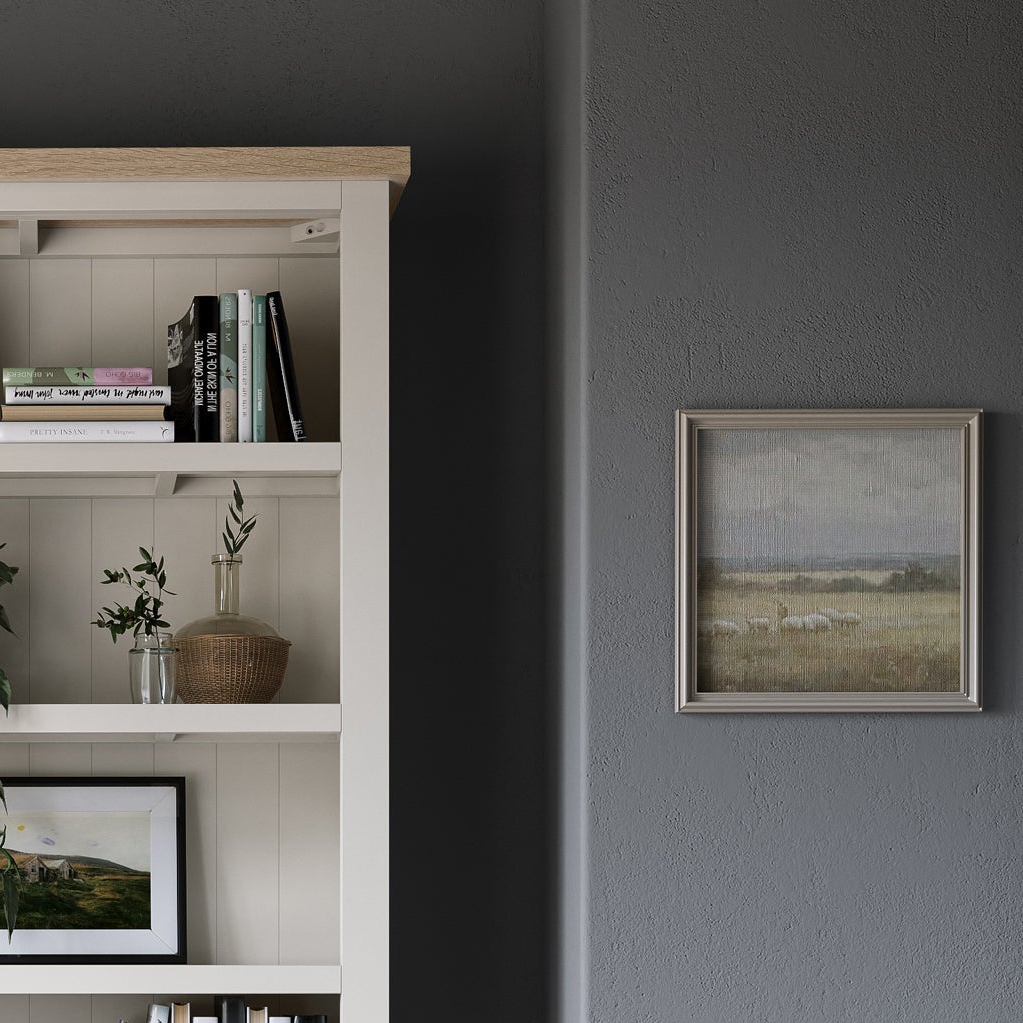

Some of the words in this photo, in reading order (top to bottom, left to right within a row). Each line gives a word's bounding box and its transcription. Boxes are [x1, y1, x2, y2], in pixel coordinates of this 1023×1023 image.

[35, 388, 53, 399] John
[114, 389, 123, 398] in
[126, 387, 148, 398] night
